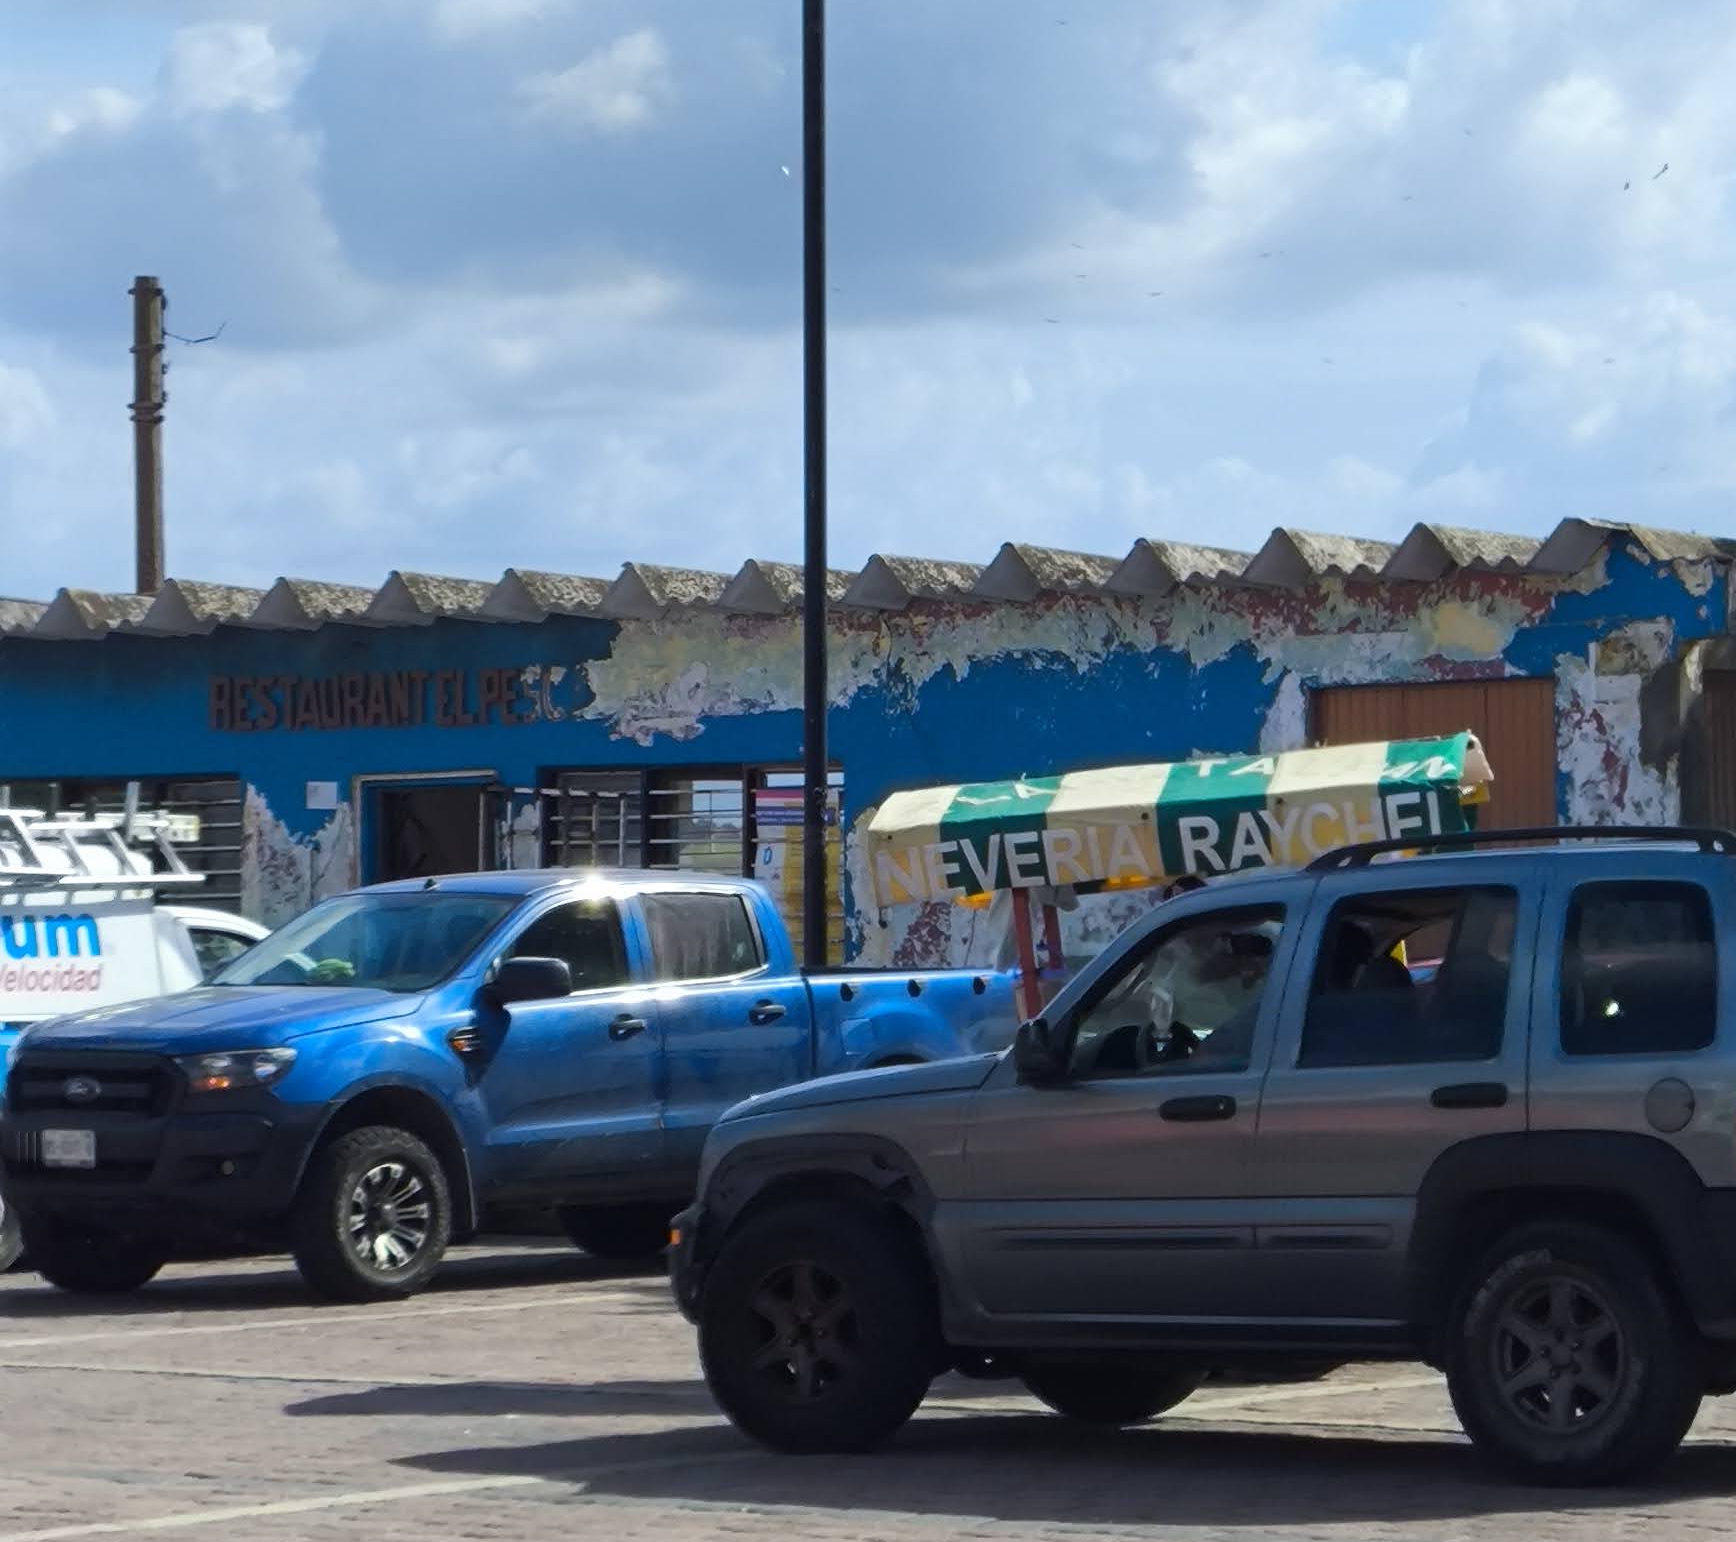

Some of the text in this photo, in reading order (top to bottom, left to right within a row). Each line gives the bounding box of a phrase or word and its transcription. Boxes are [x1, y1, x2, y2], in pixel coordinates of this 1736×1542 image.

[209, 670, 429, 732] RESTAURANT
[435, 671, 474, 727] EL
[874, 822, 1151, 908] NEVERIA
[0, 913, 102, 960] um
